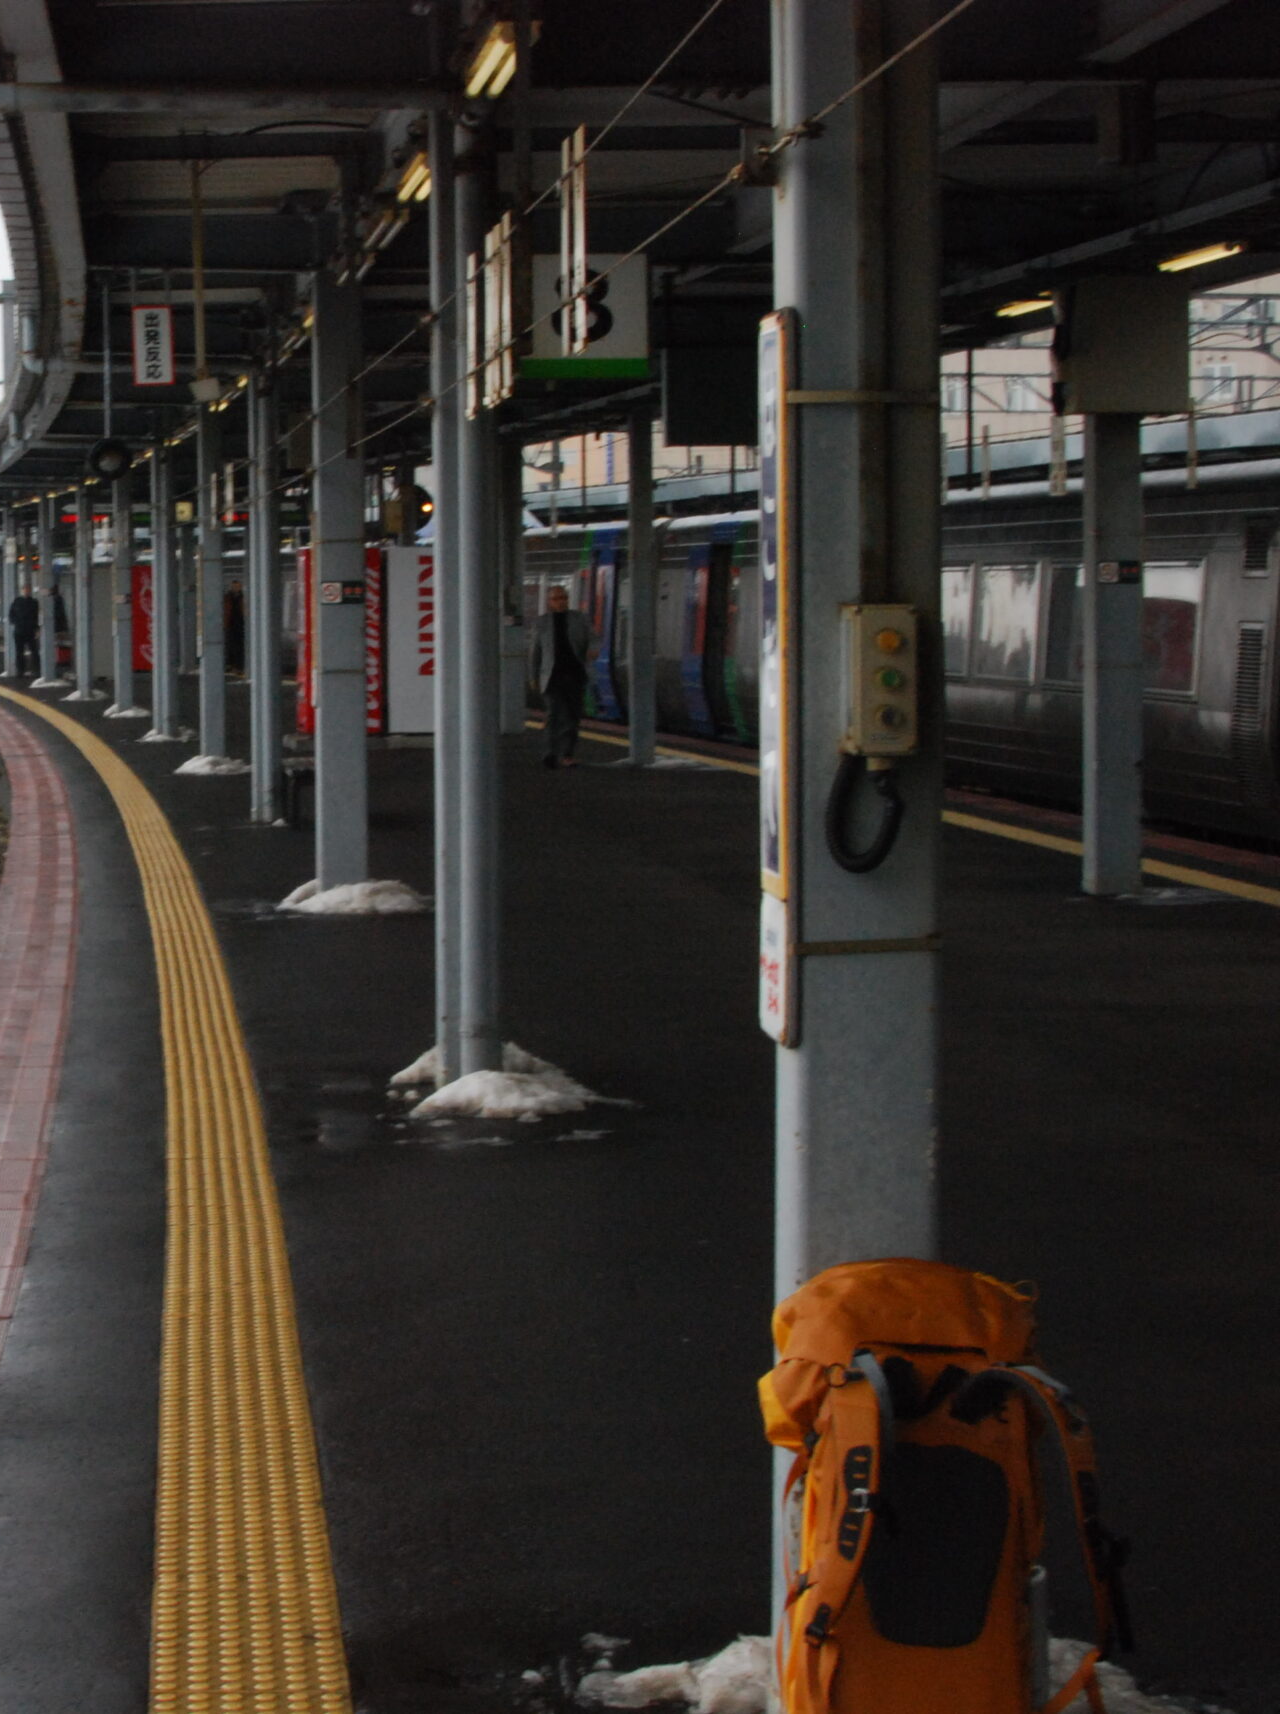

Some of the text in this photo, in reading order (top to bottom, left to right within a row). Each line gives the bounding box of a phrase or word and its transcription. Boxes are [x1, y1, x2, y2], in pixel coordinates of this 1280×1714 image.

[551, 267, 613, 344] 8
[144, 311, 162, 380] 出発反応
